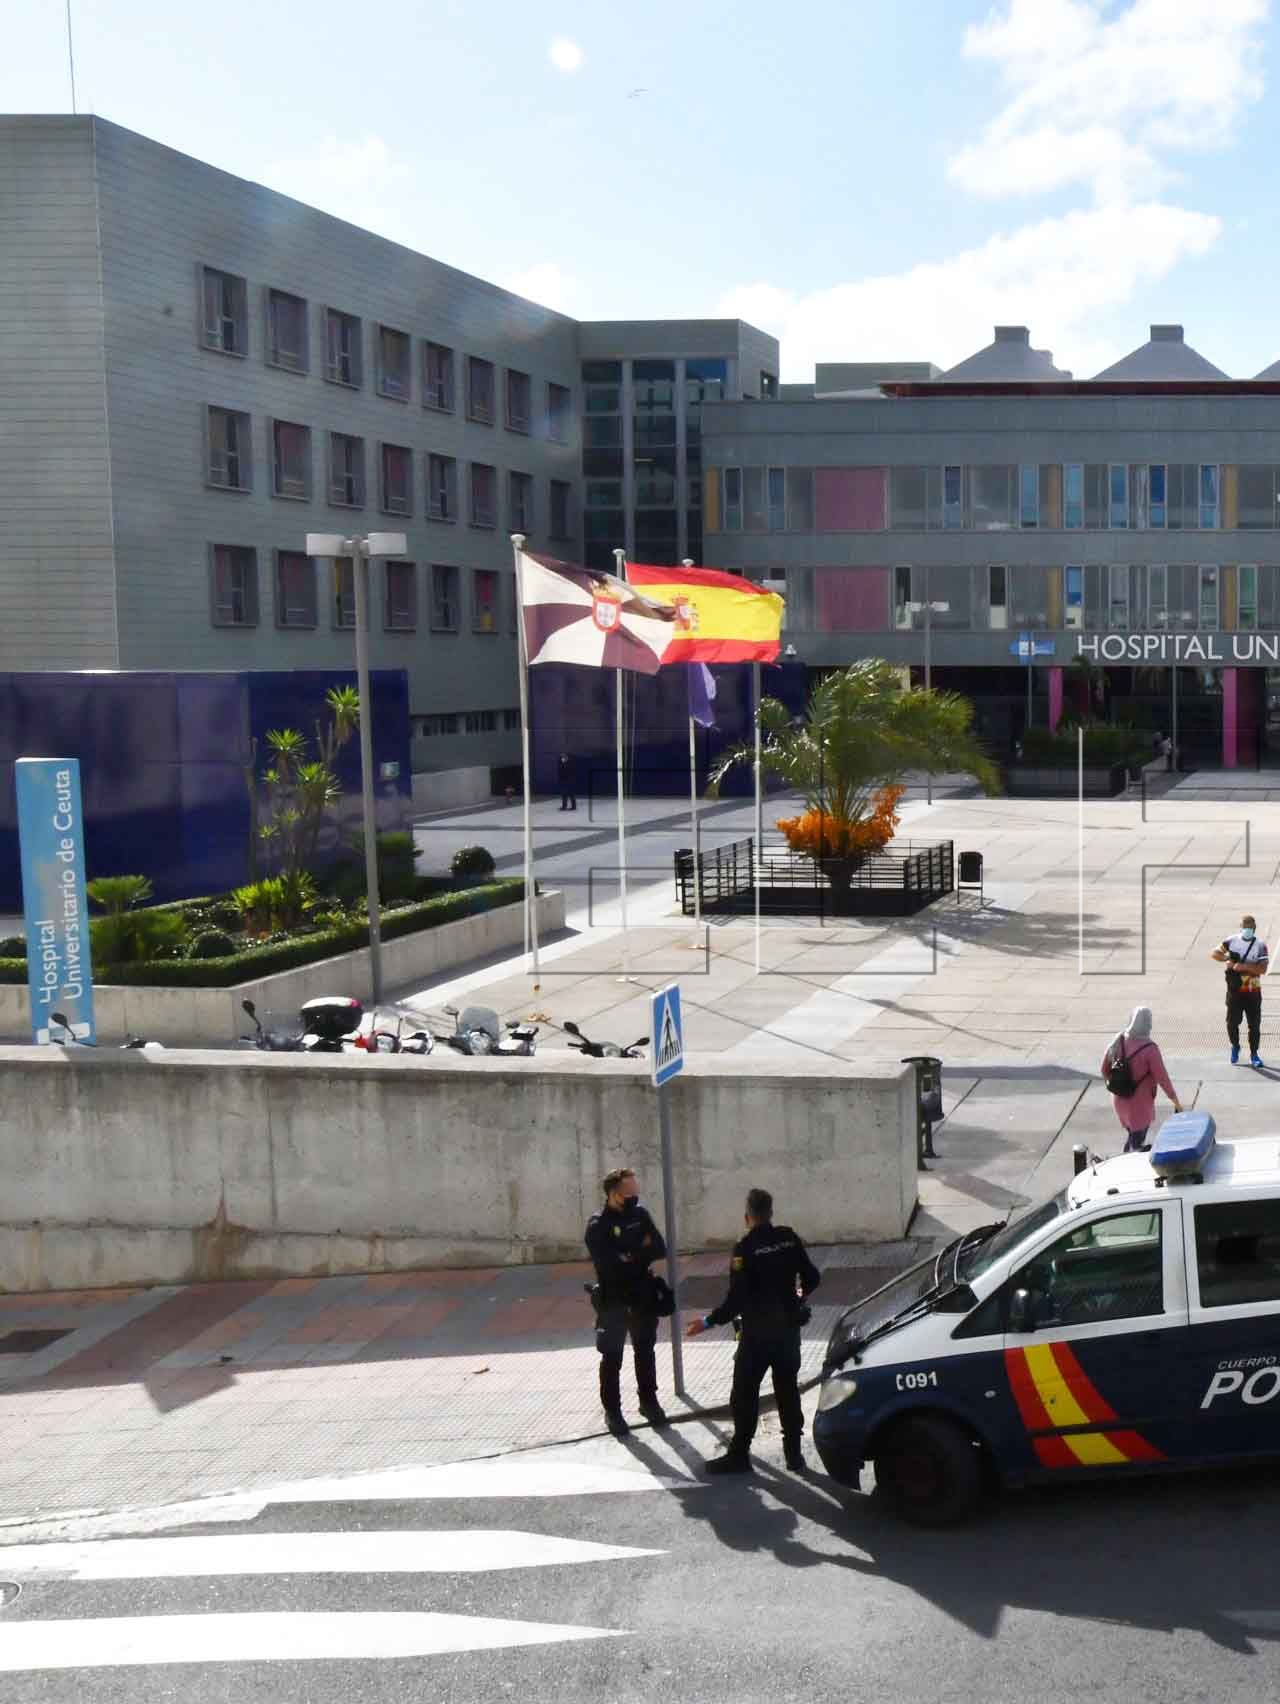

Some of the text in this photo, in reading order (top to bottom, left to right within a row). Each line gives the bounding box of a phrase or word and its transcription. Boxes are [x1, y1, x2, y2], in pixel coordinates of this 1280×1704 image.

[1077, 634, 1224, 661] HOSPITAL
[53, 768, 83, 1001] Universitario de Ceuta
[35, 919, 62, 1004] Hospital
[1217, 1355, 1277, 1370] CUERPO
[905, 1371, 938, 1390] 091
